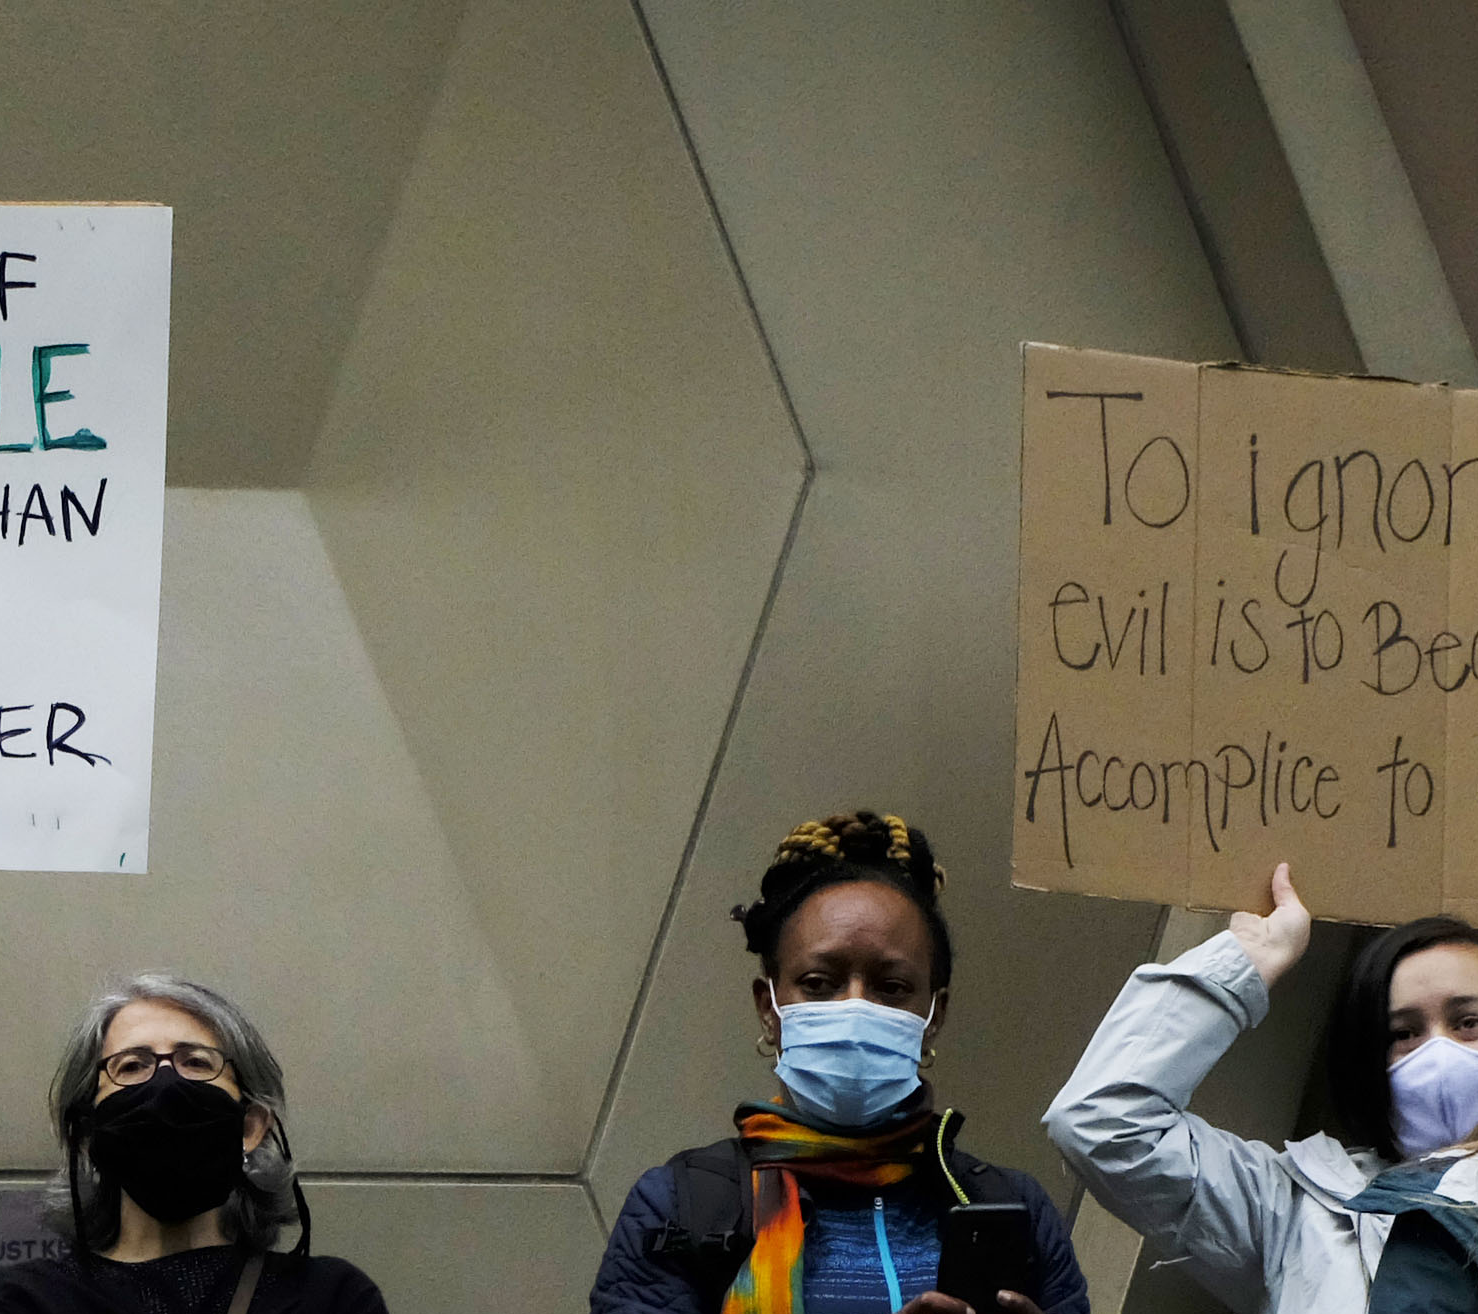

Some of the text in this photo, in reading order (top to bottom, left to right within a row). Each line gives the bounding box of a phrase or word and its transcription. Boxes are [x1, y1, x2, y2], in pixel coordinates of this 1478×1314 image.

[1047, 391, 1189, 528] To
[1048, 581, 1170, 676] evil
[1211, 580, 1270, 673] is
[1286, 610, 1343, 684] to
[1025, 711, 1340, 868] Accomplice
[1376, 735, 1433, 848] to
